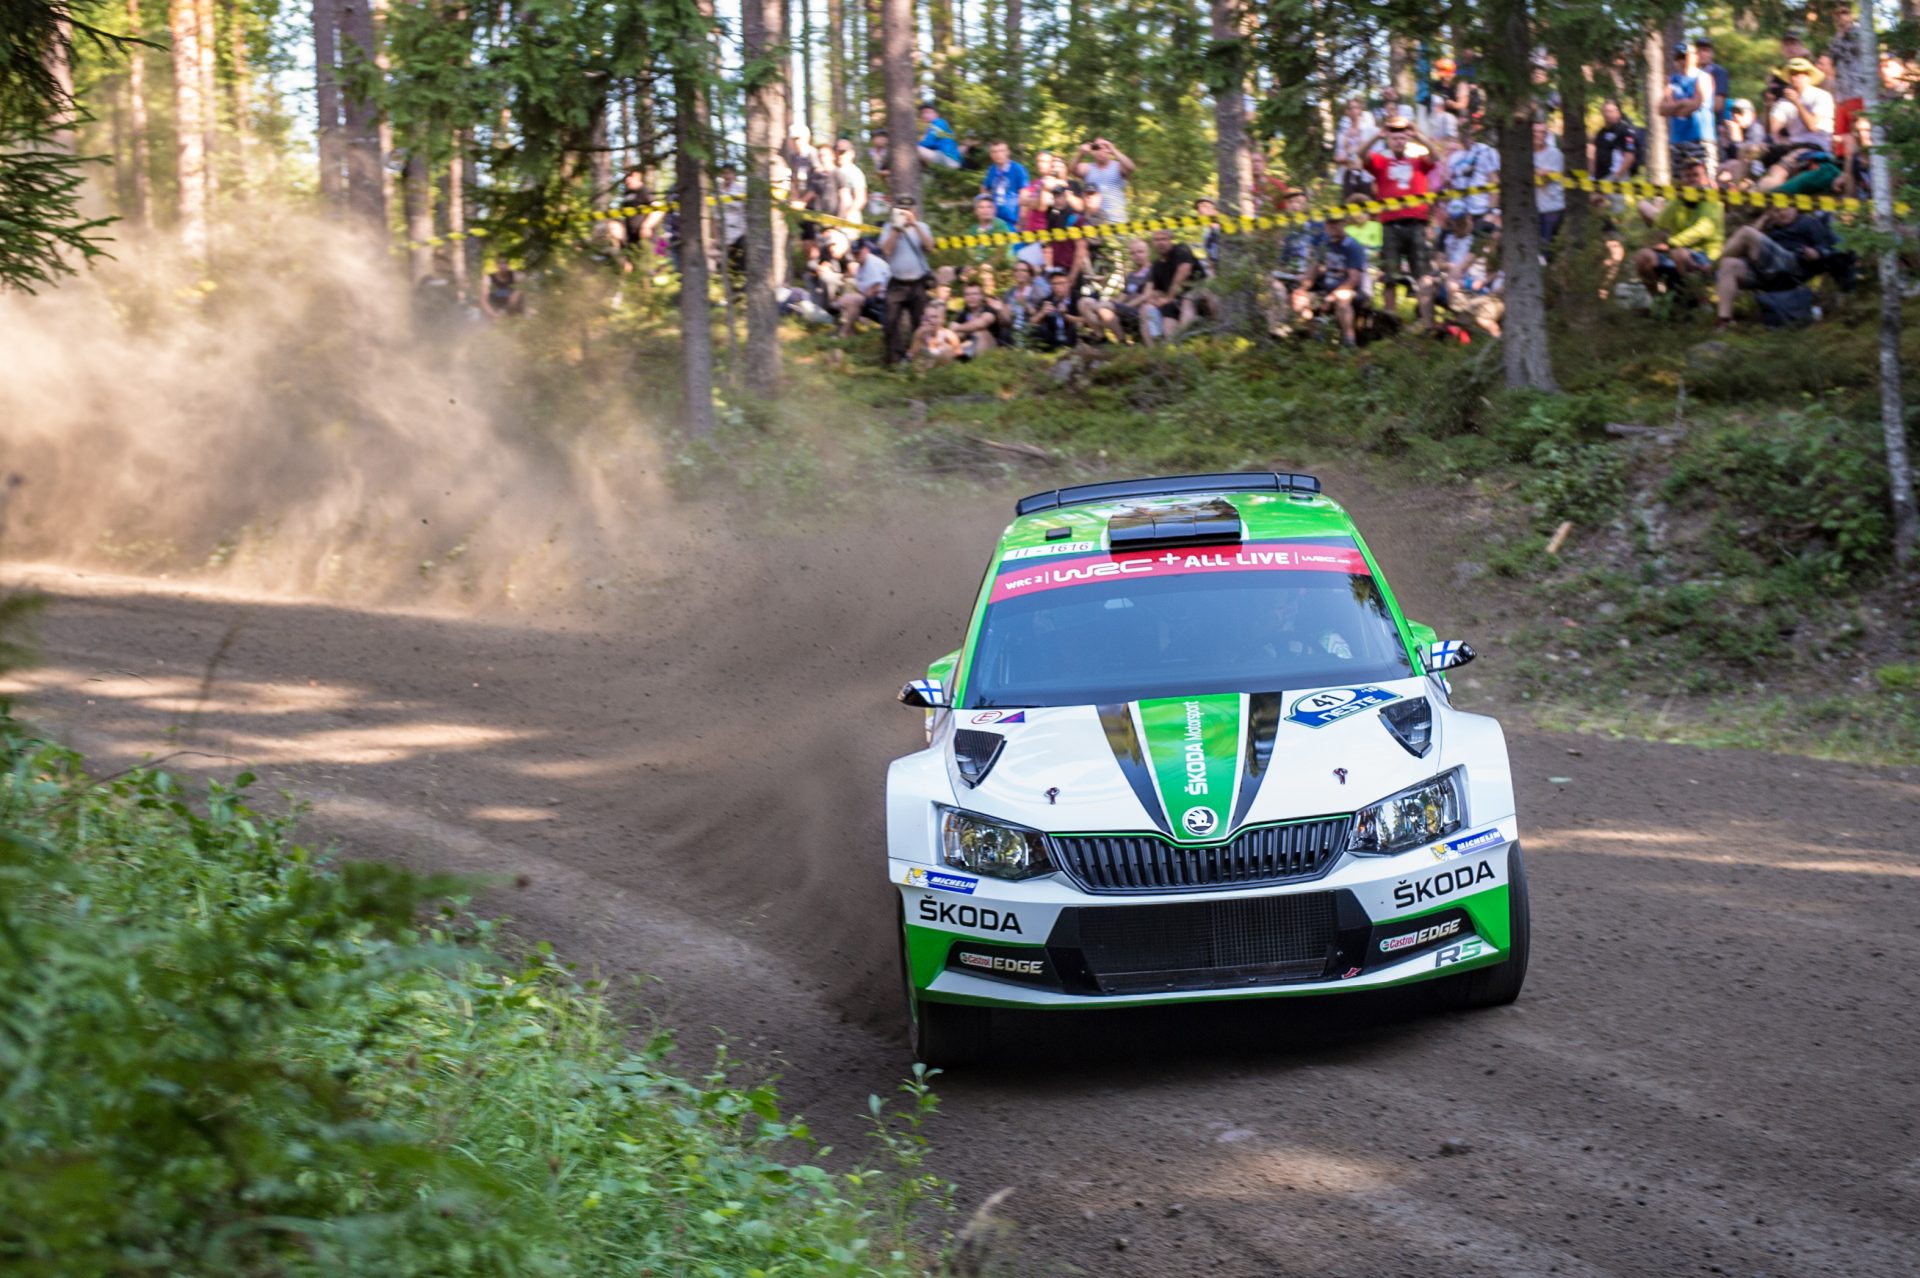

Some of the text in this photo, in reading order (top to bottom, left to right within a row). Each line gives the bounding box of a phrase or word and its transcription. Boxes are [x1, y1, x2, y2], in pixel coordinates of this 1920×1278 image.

[1005, 577, 1032, 590] WRC
[1034, 575, 1043, 584] 2
[1184, 553, 1230, 568] ALL
[1236, 552, 1290, 565] LIVE
[1311, 694, 1345, 707] 41
[1182, 701, 1208, 795] ŠKODA Motorsport
[1457, 832, 1501, 850] MICHELIN
[930, 876, 977, 889] MICHELIN
[1393, 860, 1496, 909] ŠKODA
[919, 895, 1023, 935] ŠKODA
[1389, 918, 1463, 949] Castrol EDGE
[993, 957, 1044, 974] EDGE
[1435, 940, 1482, 968] R5
